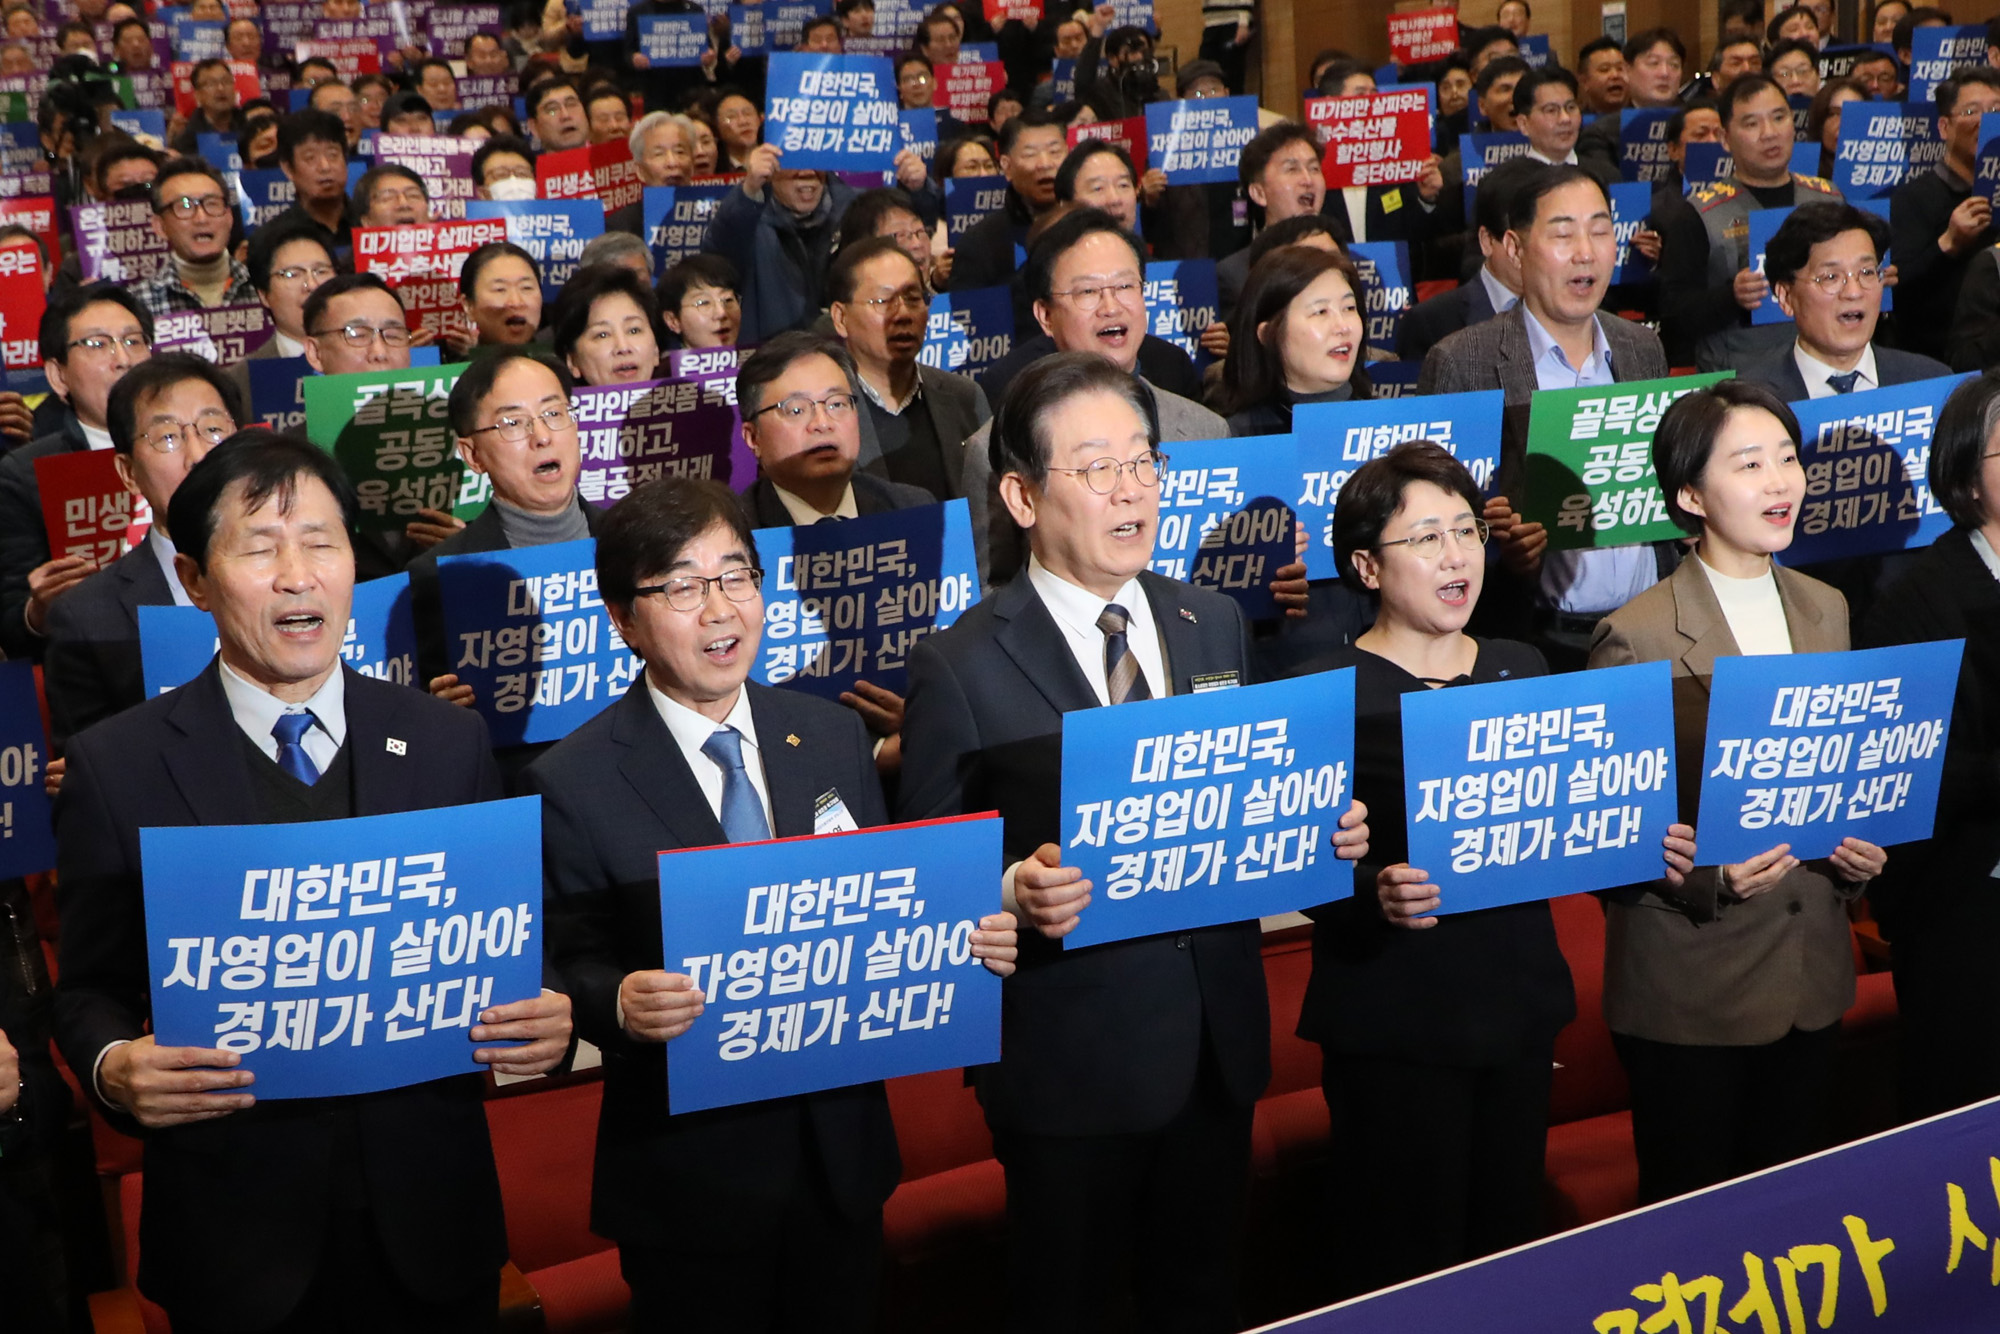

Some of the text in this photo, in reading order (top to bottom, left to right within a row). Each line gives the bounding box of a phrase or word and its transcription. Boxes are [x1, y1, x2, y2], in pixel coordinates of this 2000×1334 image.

[1938, 37, 1988, 58] 대한민
[798, 71, 880, 99] 대한민국,
[768, 97, 898, 126] 자영업이 살아야
[1171, 109, 1233, 130] 대한민국,
[1310, 98, 1370, 120] 대기업만
[1867, 116, 1931, 139] 대한민국,
[379, 136, 459, 155] 온라인플랫폼
[784, 127, 892, 152] 경제가 산다!
[1151, 131, 1208, 152] 자영업이
[1212, 128, 1256, 148] 살아야
[1166, 149, 1241, 172] 경제가 산다
[1336, 139, 1402, 165] 할인행사
[1624, 144, 1669, 162] 자영업
[1839, 140, 1906, 163] 자영업이
[546, 158, 639, 199] 민생소비쿠폰
[1352, 160, 1423, 185] 중단하라!
[1851, 164, 1903, 187] 경제가
[80, 205, 153, 231] 온라인플
[360, 227, 434, 254] 대기업만
[397, 283, 461, 310] 할인행
[154, 307, 264, 344] 온라인플랫폼
[1155, 305, 1216, 335] 살아야
[948, 333, 1011, 367] 살아야
[353, 376, 460, 426] 골목상
[1570, 388, 1700, 440] 골목상
[375, 427, 463, 471] 공동
[1816, 405, 1936, 453] 대한민국
[1582, 441, 1657, 485] 공동
[1806, 451, 1893, 497] 영업이
[357, 469, 494, 515] 육성하라
[1158, 466, 1244, 507] 한민국,
[1200, 507, 1291, 549] 살아야
[1802, 491, 1891, 535] 경제가
[776, 539, 917, 592] 대한민국,
[1194, 554, 1265, 590] 산다!
[507, 569, 604, 616] 대한민
[764, 573, 972, 640] 영업이 살아야
[457, 615, 598, 669] 자영업이
[765, 638, 868, 684] 경제가
[494, 662, 600, 713] 경제가
[1769, 677, 1903, 727] 대한민국,
[1131, 718, 1295, 784] 대한민국,
[1467, 703, 1614, 763] 대한민국,
[1710, 719, 1943, 781] 자영업이 살아야
[1070, 761, 1347, 848] 자영업이 살아야
[1415, 748, 1668, 824] 자영업이 살아야
[1739, 773, 1912, 830] 경제가 산다!
[1450, 806, 1642, 874] 경제가 산다!
[1106, 826, 1319, 900] 경제가 산다!
[239, 852, 457, 922] 대한민국,
[743, 867, 925, 936] 대한민국,
[162, 903, 533, 991] 자영업이 살아야
[682, 935, 854, 1004] 자영업이
[213, 976, 494, 1055] 경제가 산다!
[718, 983, 955, 1062] 경제가 산다!
